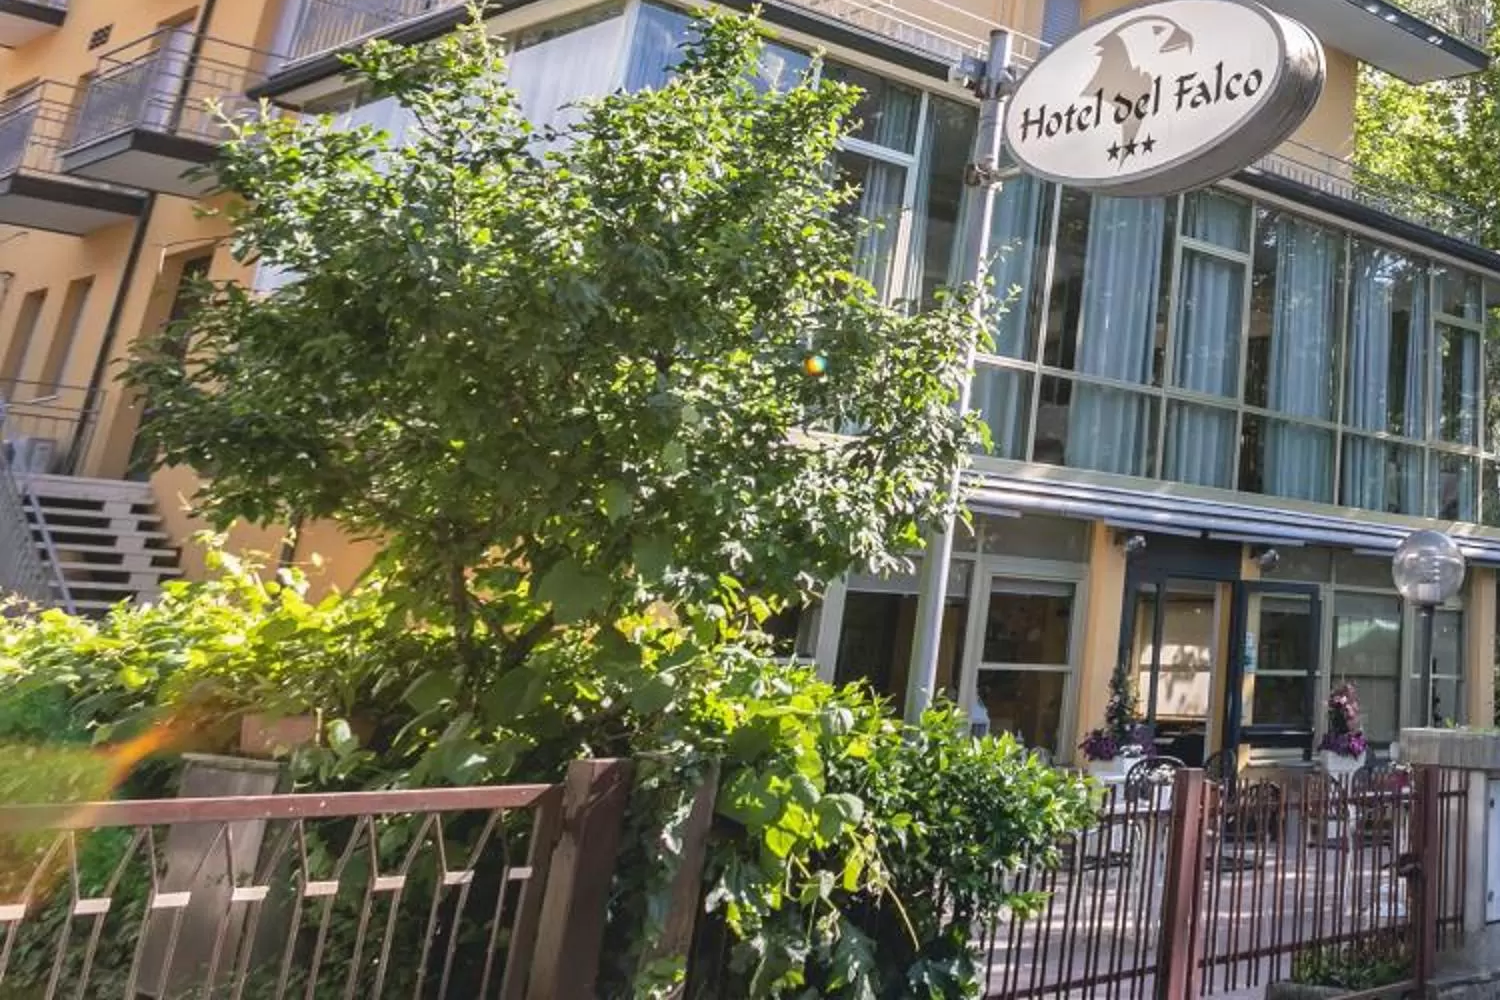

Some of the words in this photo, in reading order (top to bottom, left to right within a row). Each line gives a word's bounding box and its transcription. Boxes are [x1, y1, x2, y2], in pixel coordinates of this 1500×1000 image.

[1020, 88, 1103, 142] Hotel
[1113, 76, 1161, 125] del
[1174, 61, 1263, 112] Falco
